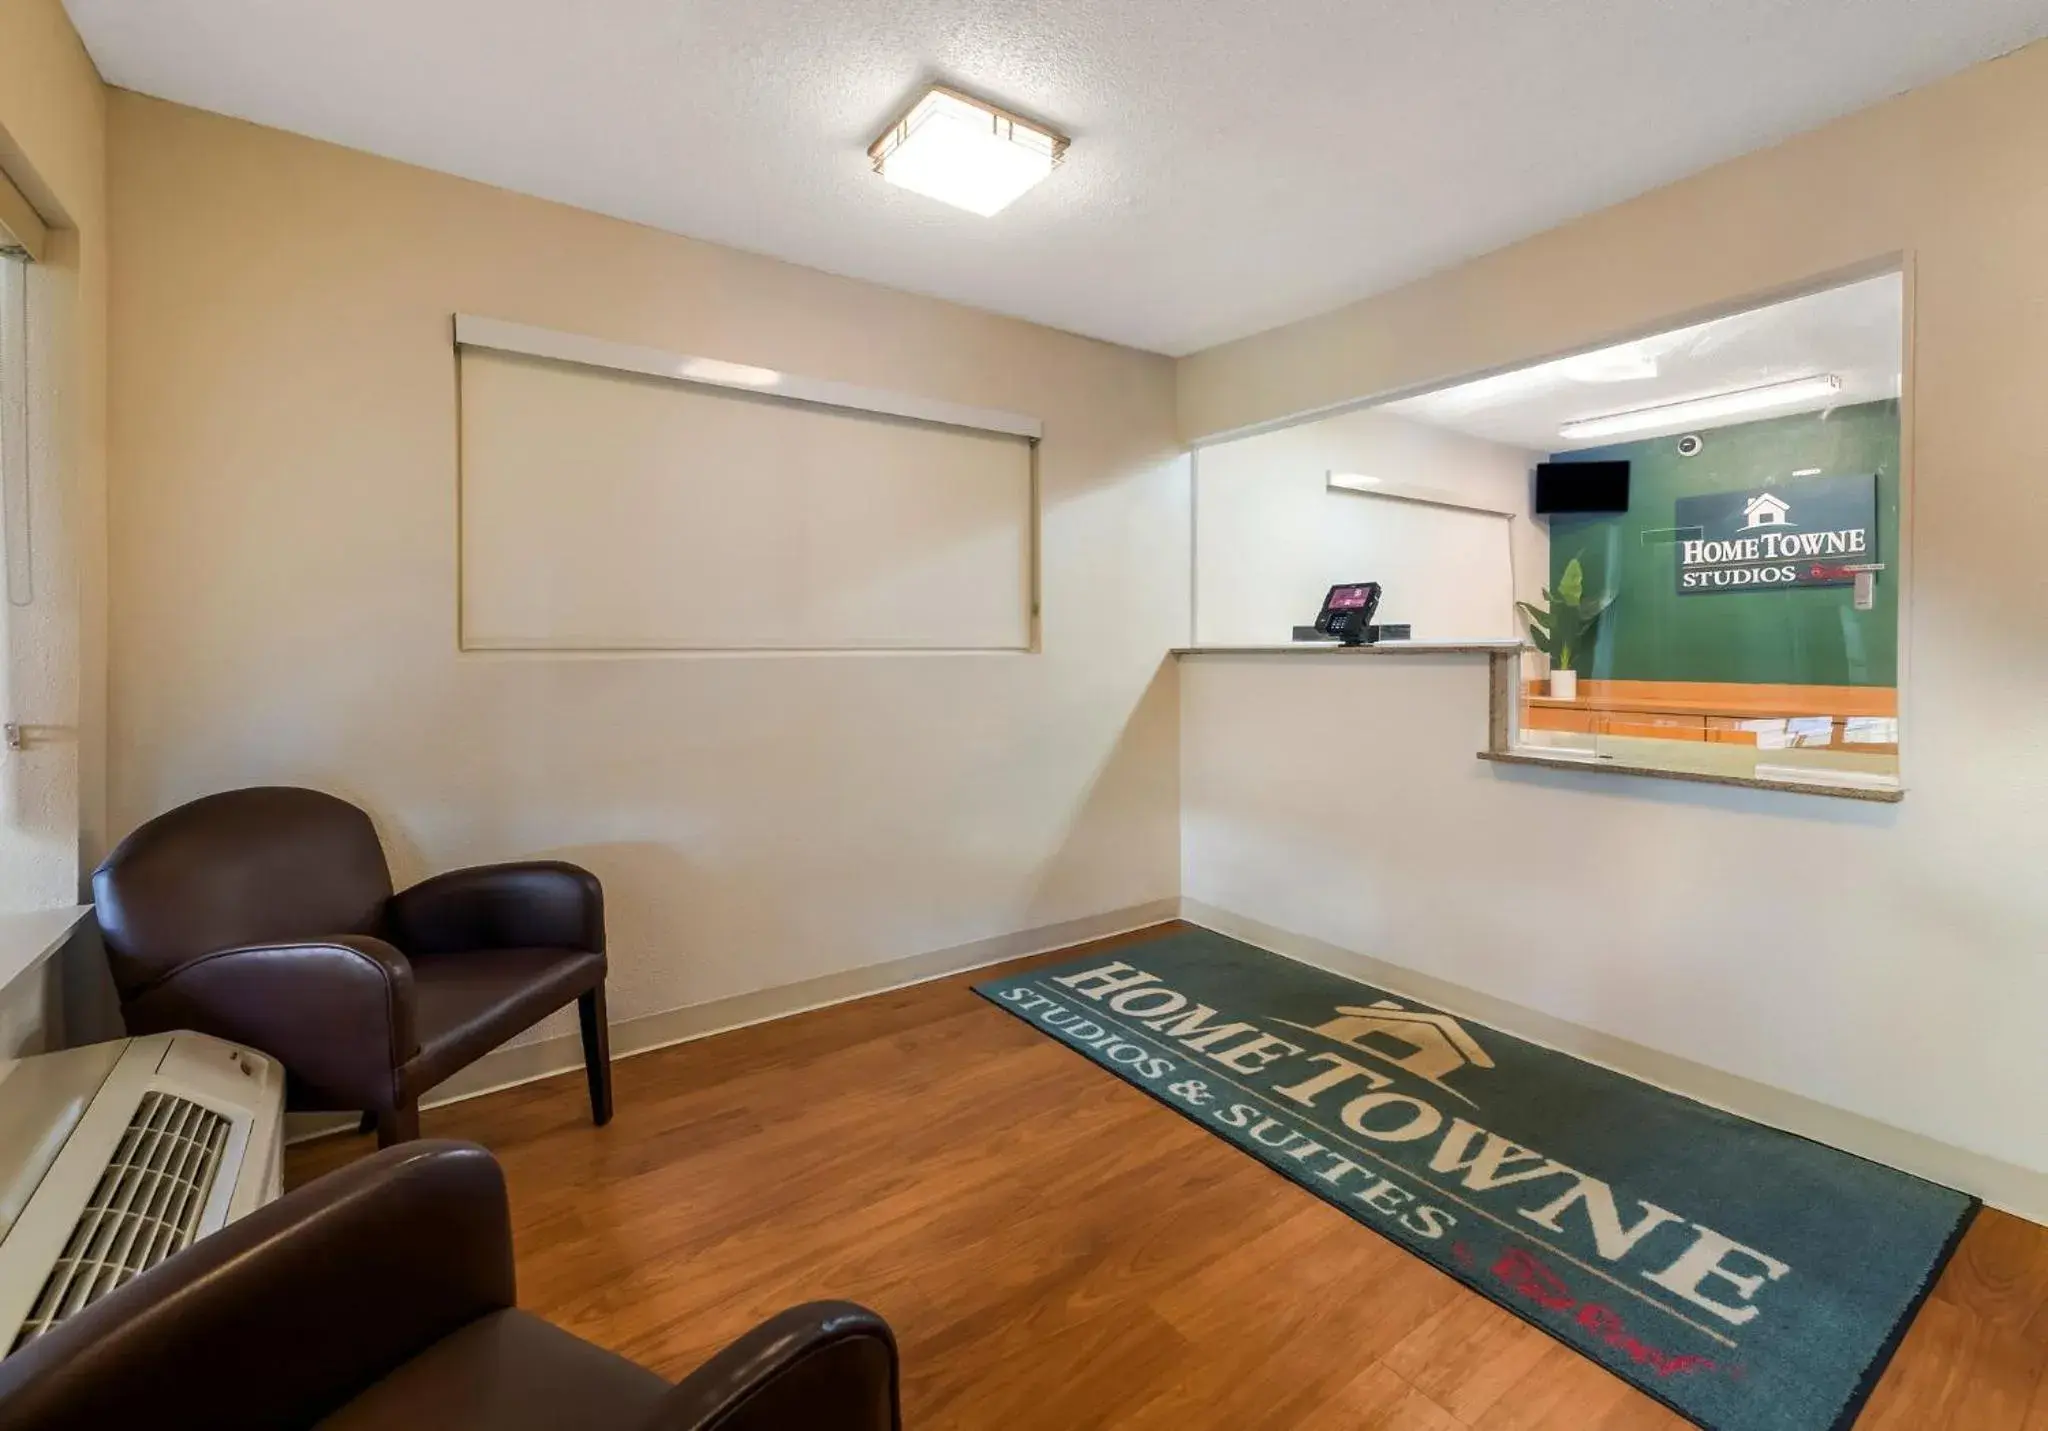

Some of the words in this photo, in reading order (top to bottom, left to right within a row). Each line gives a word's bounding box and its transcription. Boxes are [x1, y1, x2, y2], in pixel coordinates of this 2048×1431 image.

[1683, 566, 1796, 587] STUDIOS
[1000, 986, 1176, 1080] STUDIOS
[1167, 1079, 1216, 1106] &
[1213, 1102, 1457, 1239] SUITES
